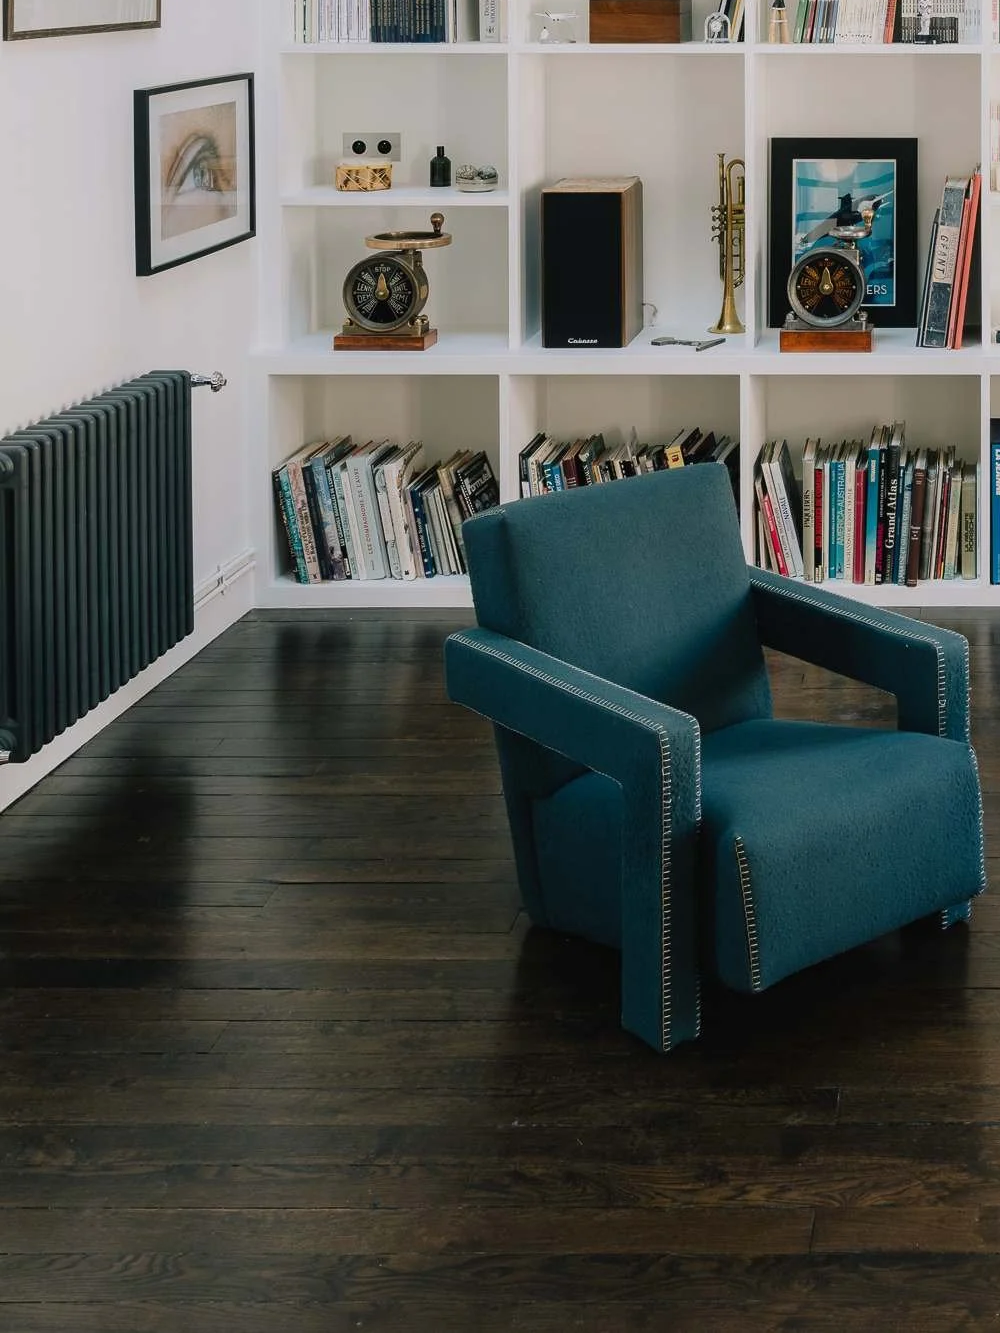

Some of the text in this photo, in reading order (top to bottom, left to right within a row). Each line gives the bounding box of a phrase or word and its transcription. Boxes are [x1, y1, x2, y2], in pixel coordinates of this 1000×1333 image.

[778, 496, 791, 520] NAVALE
[885, 478, 898, 509] Atlas
[883, 511, 896, 548] Grand
